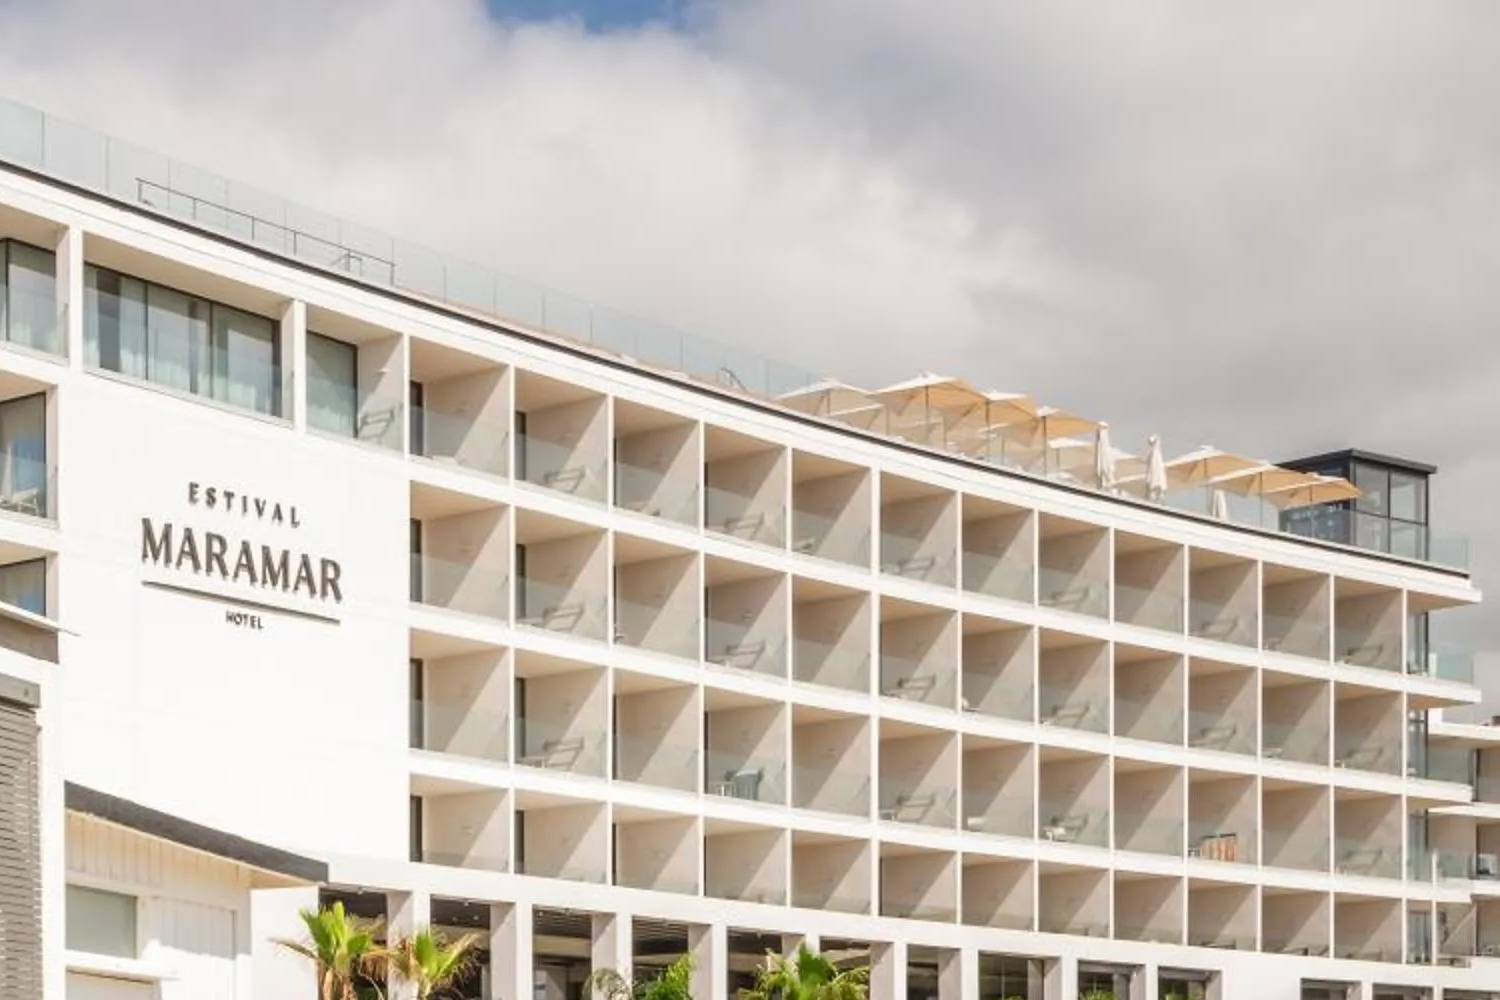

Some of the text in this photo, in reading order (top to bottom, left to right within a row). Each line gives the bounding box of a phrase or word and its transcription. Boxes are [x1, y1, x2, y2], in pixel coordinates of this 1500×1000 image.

[188, 481, 301, 528] ESTIVAL
[141, 517, 342, 604] MARAMAR
[225, 610, 264, 630] HOTEL
